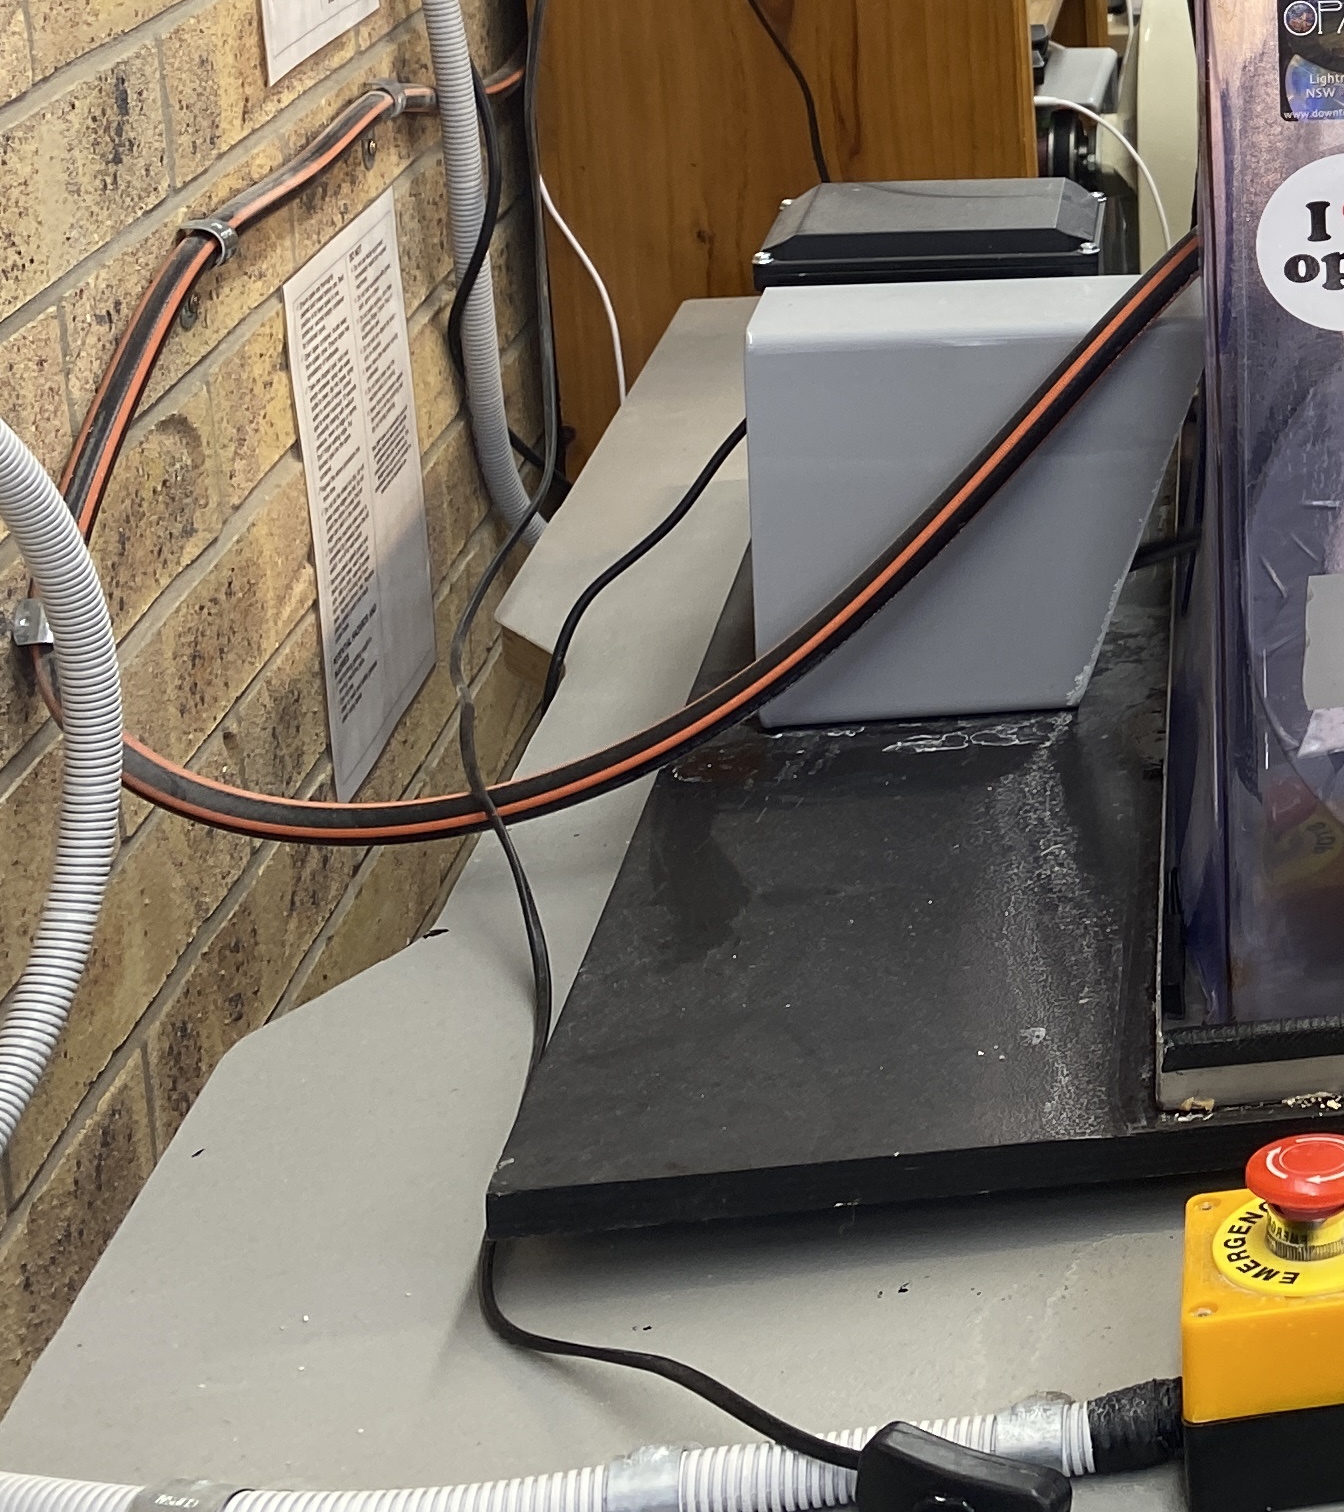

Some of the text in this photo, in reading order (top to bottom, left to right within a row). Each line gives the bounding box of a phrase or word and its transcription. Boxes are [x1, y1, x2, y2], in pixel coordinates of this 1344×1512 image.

[1305, 87, 1336, 98] NSW
[1305, 200, 1331, 242] I
[1223, 1201, 1301, 1285] EMERGENC
